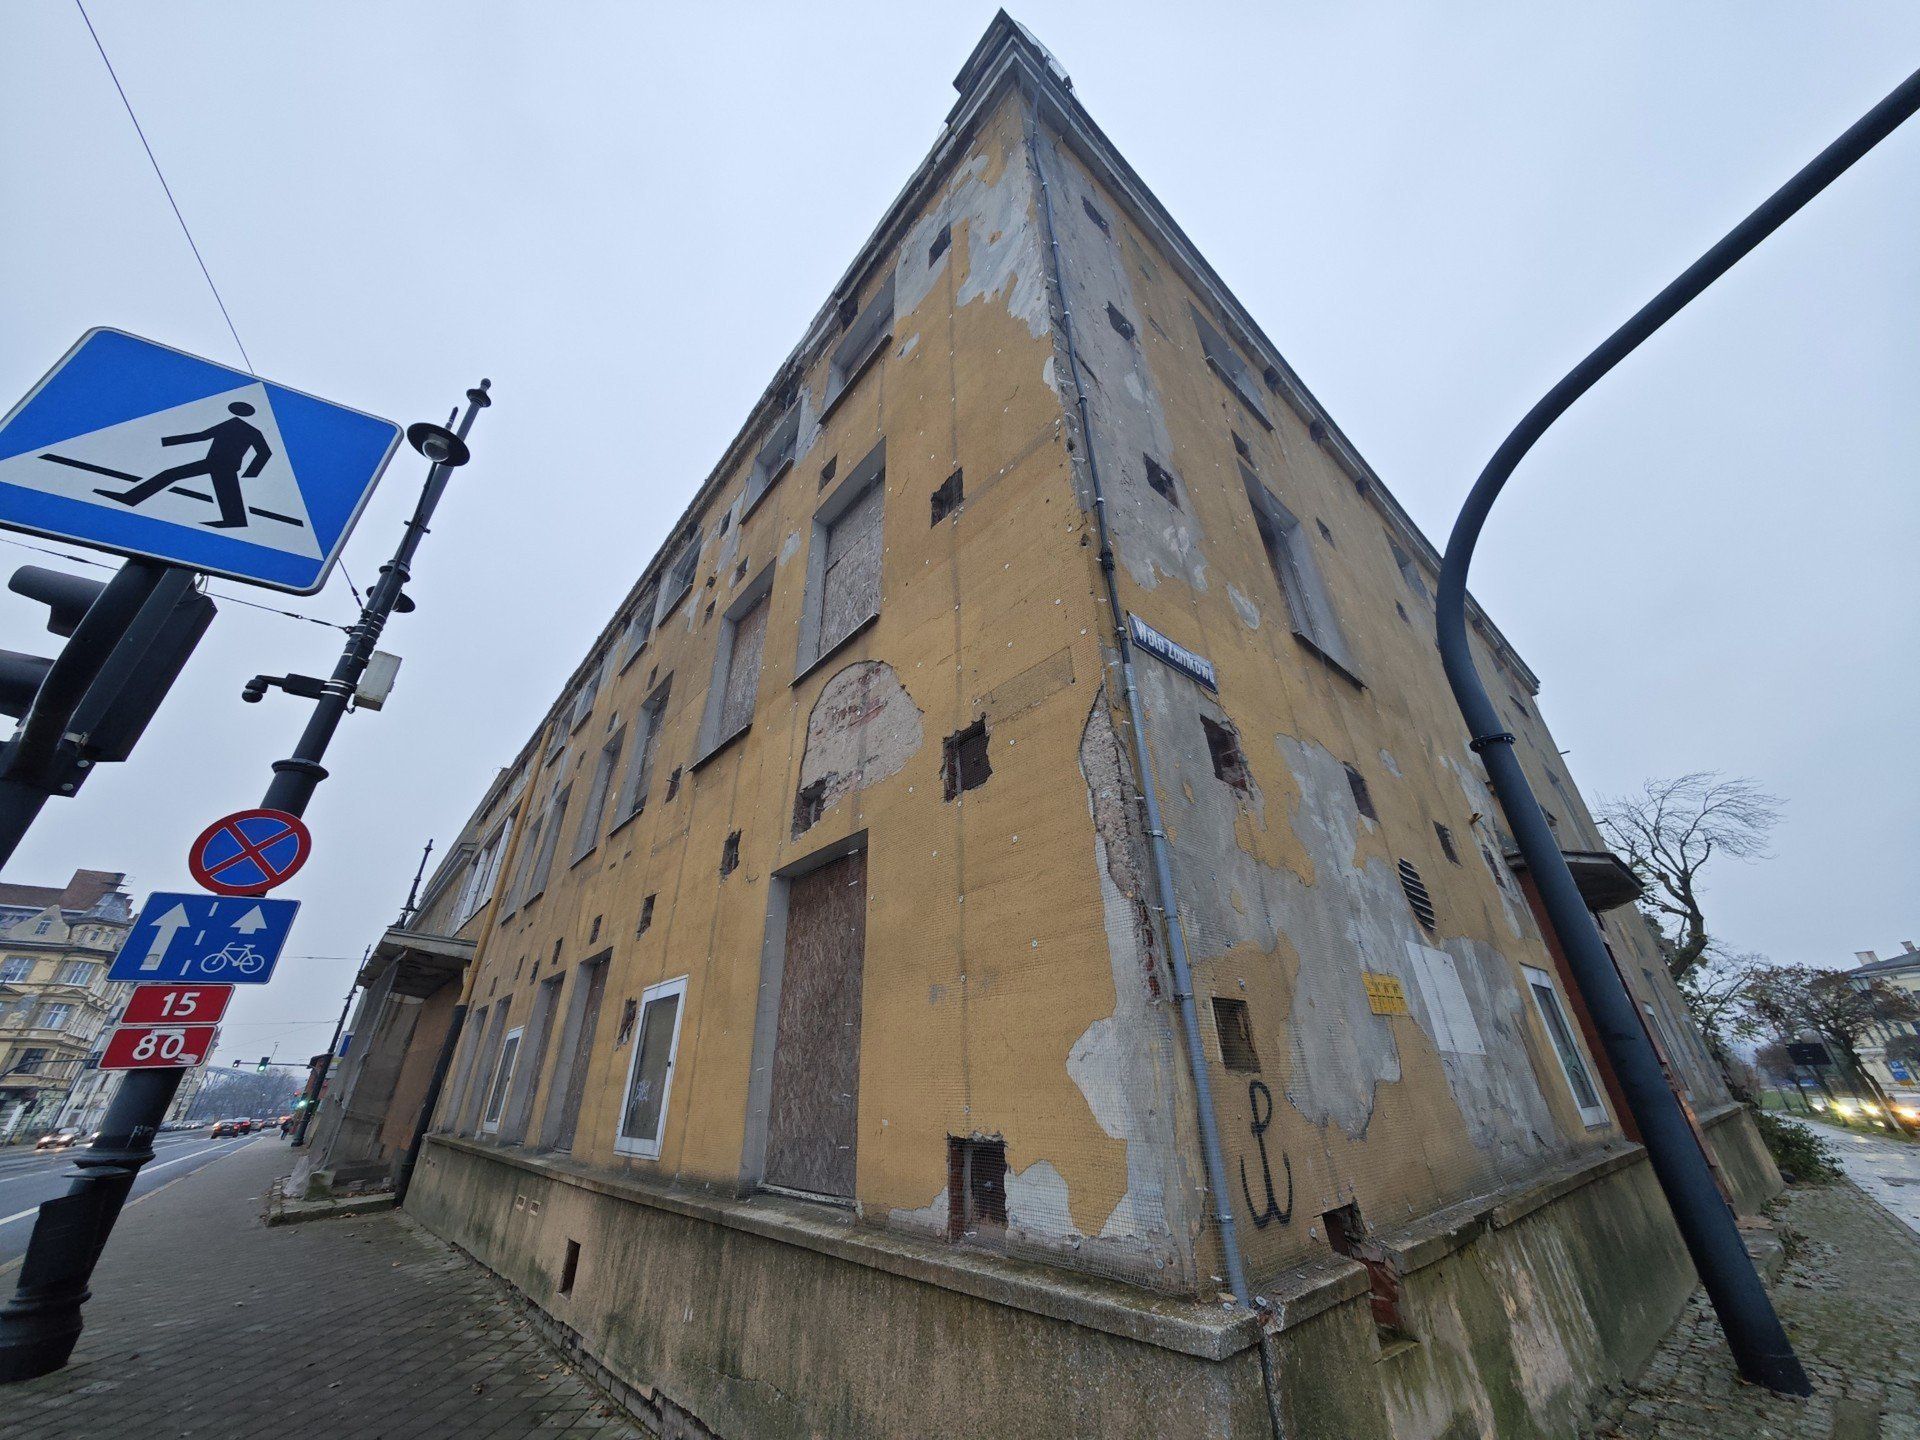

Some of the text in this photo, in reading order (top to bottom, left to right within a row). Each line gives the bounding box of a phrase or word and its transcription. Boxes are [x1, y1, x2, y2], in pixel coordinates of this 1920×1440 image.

[1135, 620, 1165, 653] Wola
[160, 991, 201, 1017] 15
[132, 1033, 186, 1061] 80
